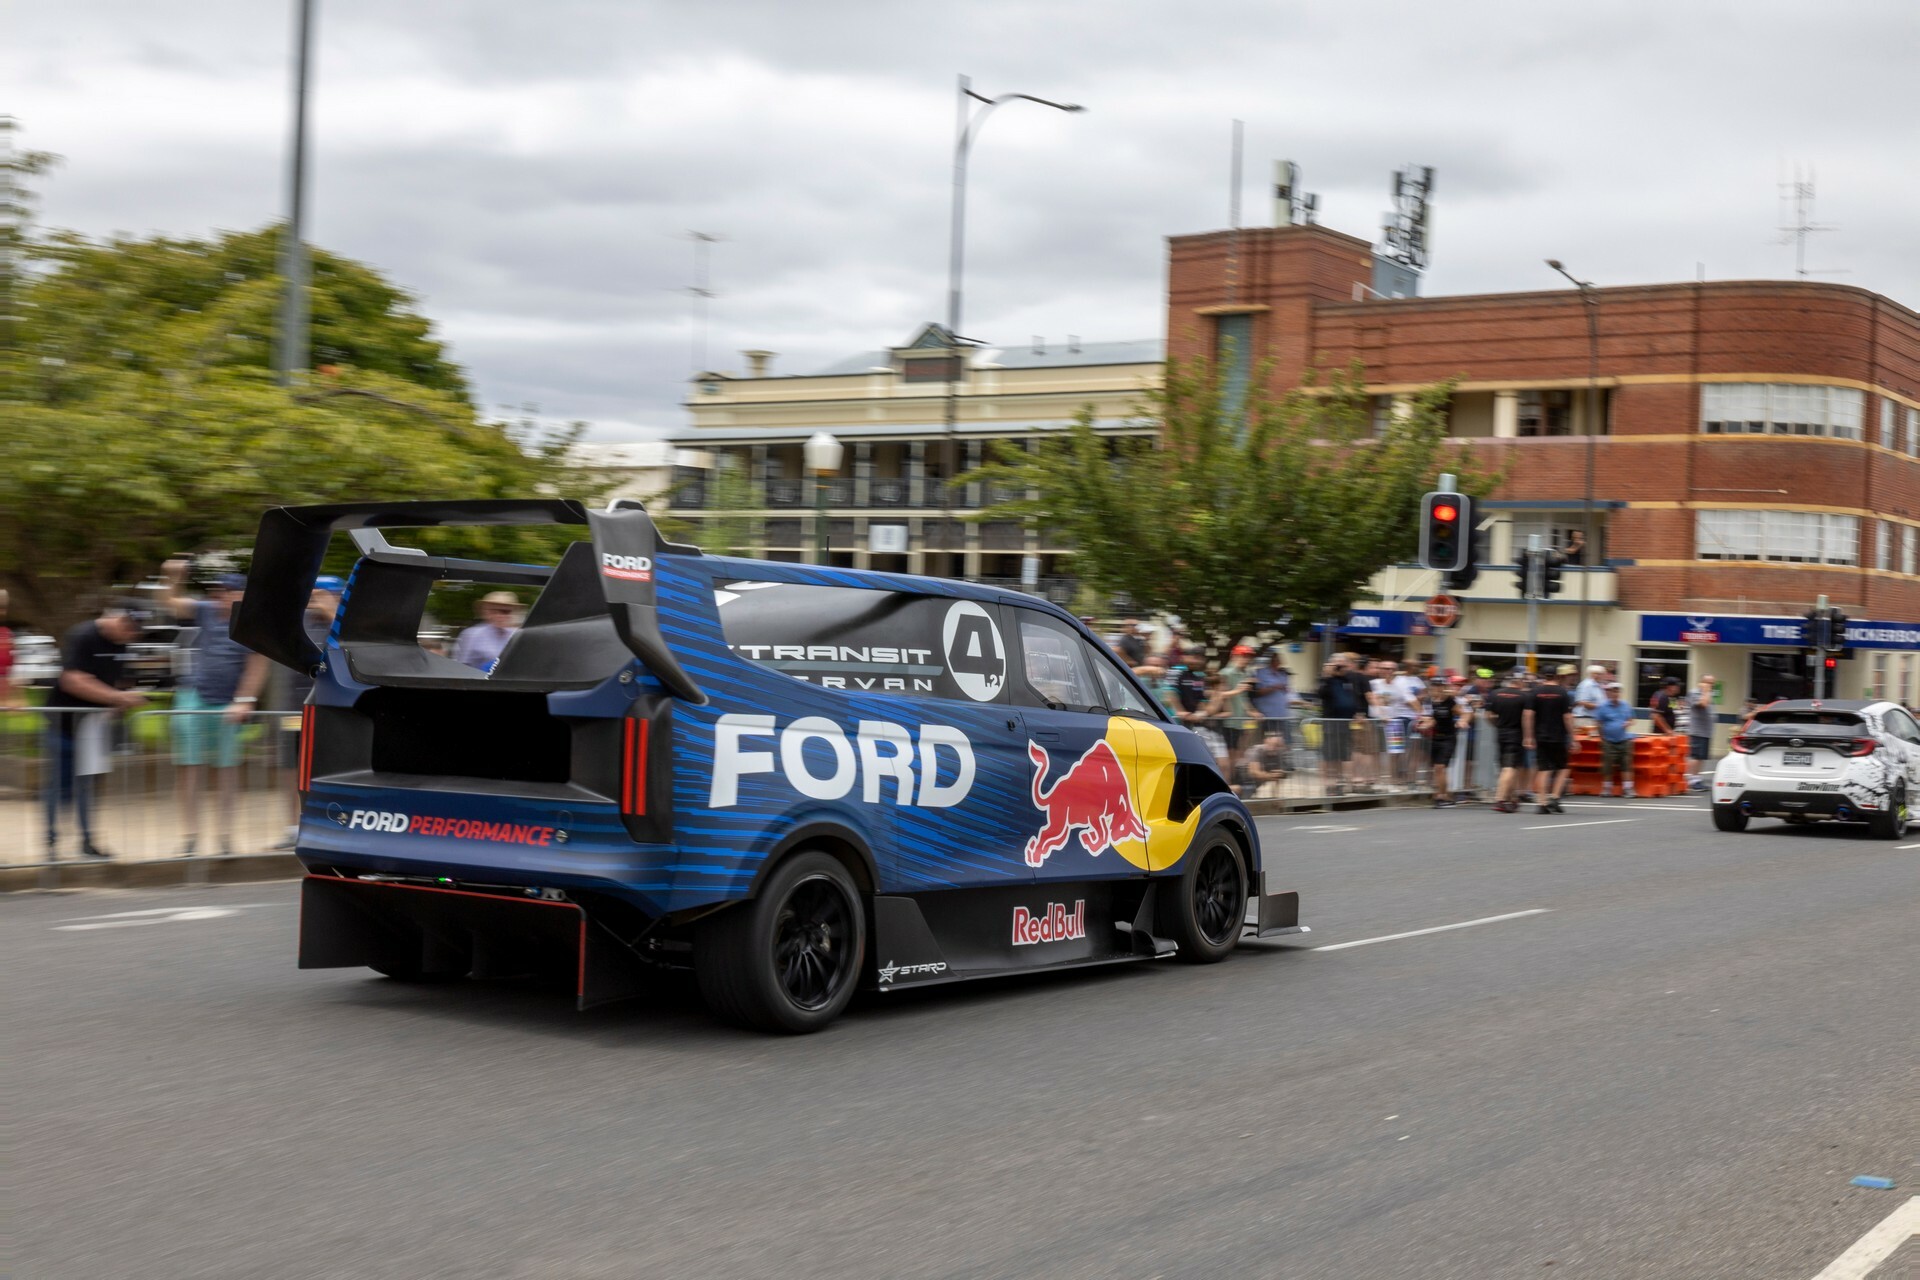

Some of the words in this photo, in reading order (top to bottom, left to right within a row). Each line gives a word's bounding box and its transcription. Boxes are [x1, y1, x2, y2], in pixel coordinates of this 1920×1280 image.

[602, 552, 652, 571] FORD
[709, 713, 976, 808] FORD
[349, 809, 409, 833] FORD
[408, 815, 554, 847] PERFORMANCE
